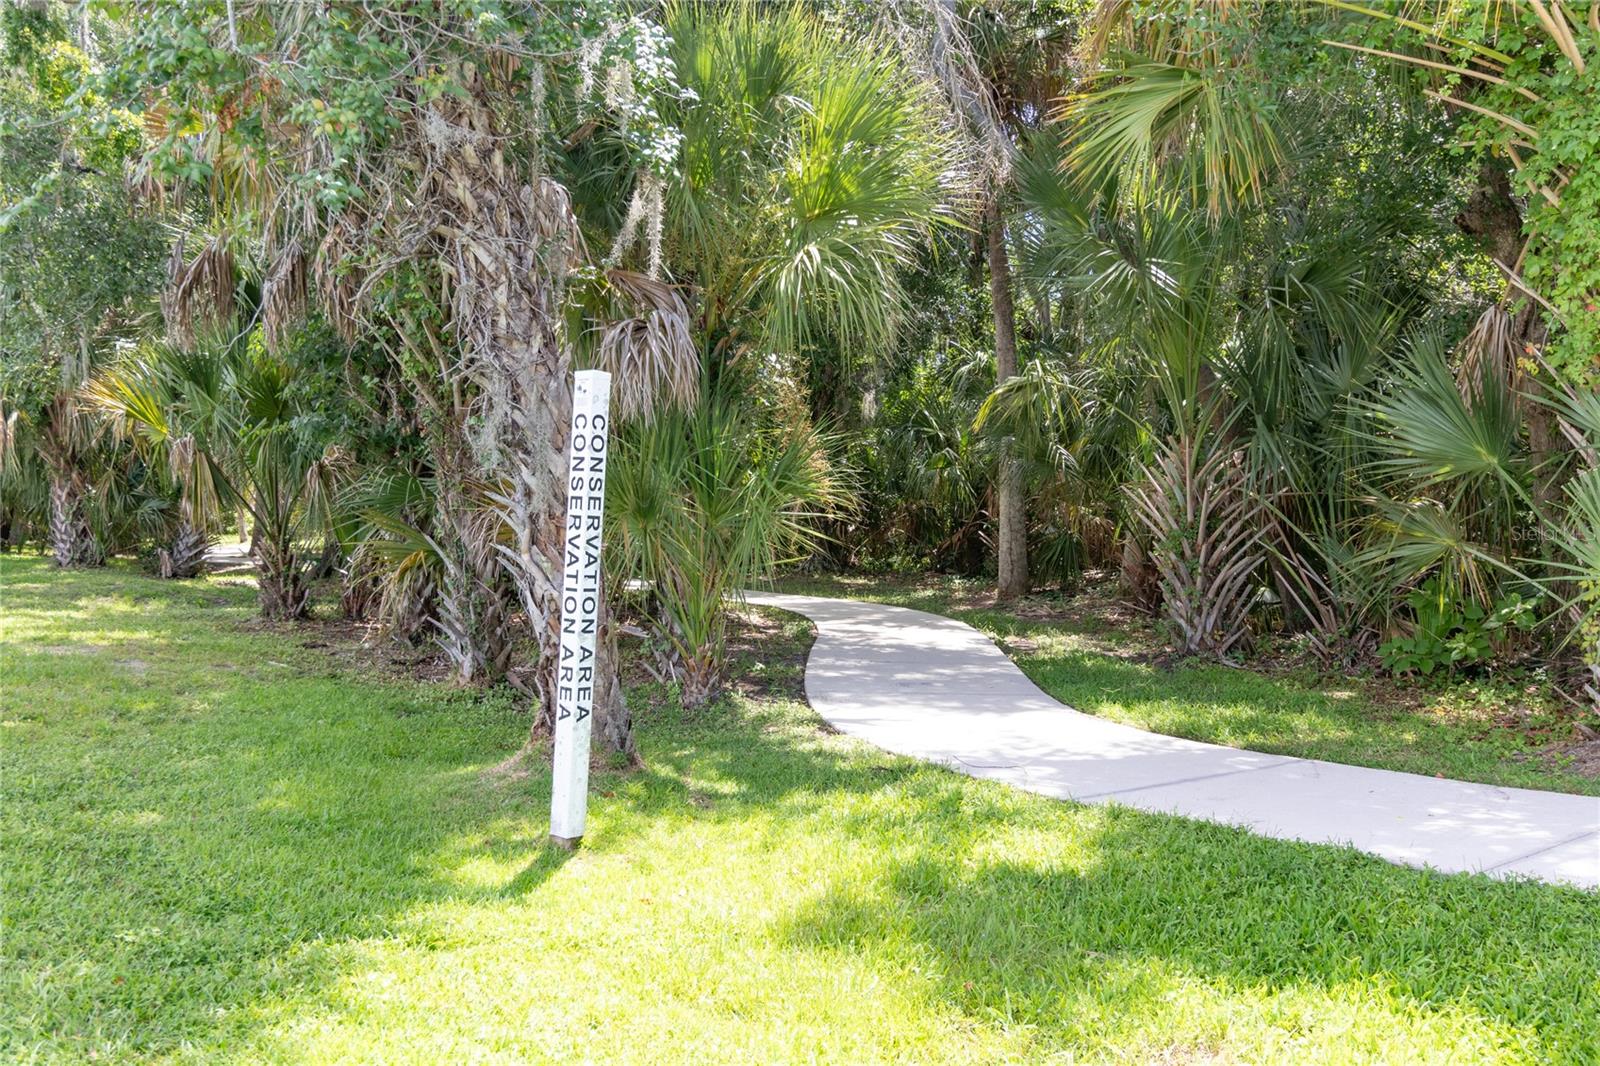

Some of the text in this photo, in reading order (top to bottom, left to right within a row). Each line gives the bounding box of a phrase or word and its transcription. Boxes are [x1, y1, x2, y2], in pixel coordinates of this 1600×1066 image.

[558, 413, 587, 721] CONSERVATION AREA
[576, 414, 606, 722] CONSERVATION AREA
